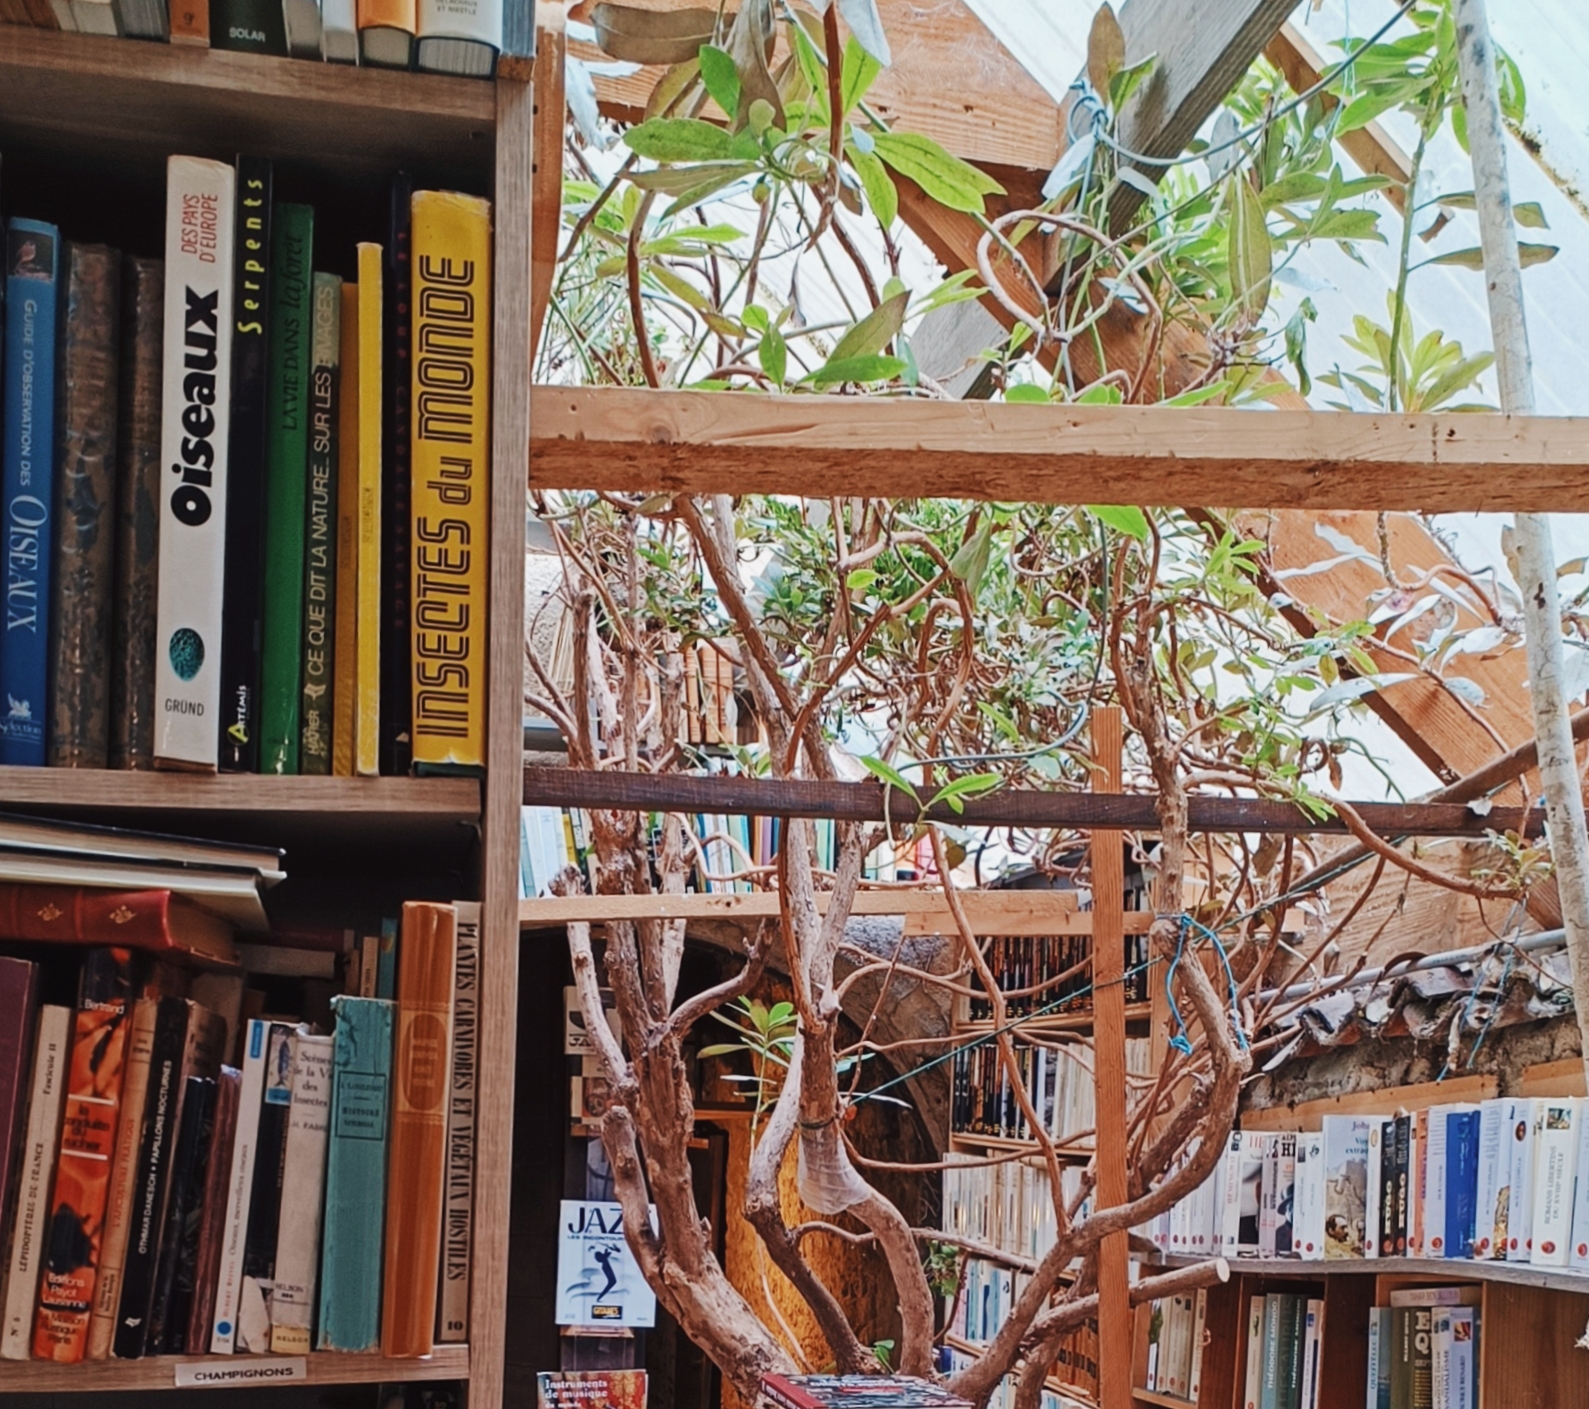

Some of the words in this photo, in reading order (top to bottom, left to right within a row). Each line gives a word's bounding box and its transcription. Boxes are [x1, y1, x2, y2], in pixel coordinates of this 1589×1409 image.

[229, 27, 266, 43] SOLAR
[183, 194, 199, 227] PAYS
[200, 194, 218, 264] D'EUROPE
[181, 229, 198, 254] DES
[237, 179, 265, 335] Serpents
[22, 299, 39, 345] GUIDE
[316, 286, 333, 366] RIVAGES
[283, 318, 300, 371] DANS
[418, 255, 474, 444] MONDE
[19, 349, 36, 457] D'OBSERVATION
[170, 285, 218, 526] Oiseaux
[283, 376, 298, 405] VIE
[315, 372, 332, 408] LES
[282, 407, 299, 430] LA
[314, 413, 331, 453] SUR
[18, 460, 33, 486] DES
[427, 456, 472, 505] du
[7, 495, 48, 634] OISEAUX
[311, 546, 327, 568] LA
[310, 571, 326, 601] DIT
[308, 606, 326, 645] QUE
[416, 517, 470, 738] INSECTES
[308, 649, 324, 676] CE
[308, 710, 320, 755] HATIER
[455, 923, 478, 991] PLANTES
[453, 998, 474, 1089] CARNIVORES
[156, 1060, 172, 1114] NOCTURNES
[302, 1080, 318, 1091] des
[452, 1098, 472, 1118] ET
[151, 1116, 165, 1164] PAPILLONS
[449, 1125, 474, 1200] VÉGÉTAUX
[143, 1173, 157, 1216] DANESCH
[138, 1217, 152, 1254] OTHMAR
[568, 1206, 627, 1235] JAZ
[447, 1209, 469, 1280] HOSTILES
[42, 1295, 87, 1310] Lausanne
[50, 1286, 77, 1299] Payot
[448, 1320, 464, 1330] 10
[195, 1367, 293, 1381] CHAMPIGNONS
[1266, 1340, 1276, 1389] THÉODORE
[545, 1389, 558, 1399] de
[562, 1388, 608, 1400] musique
